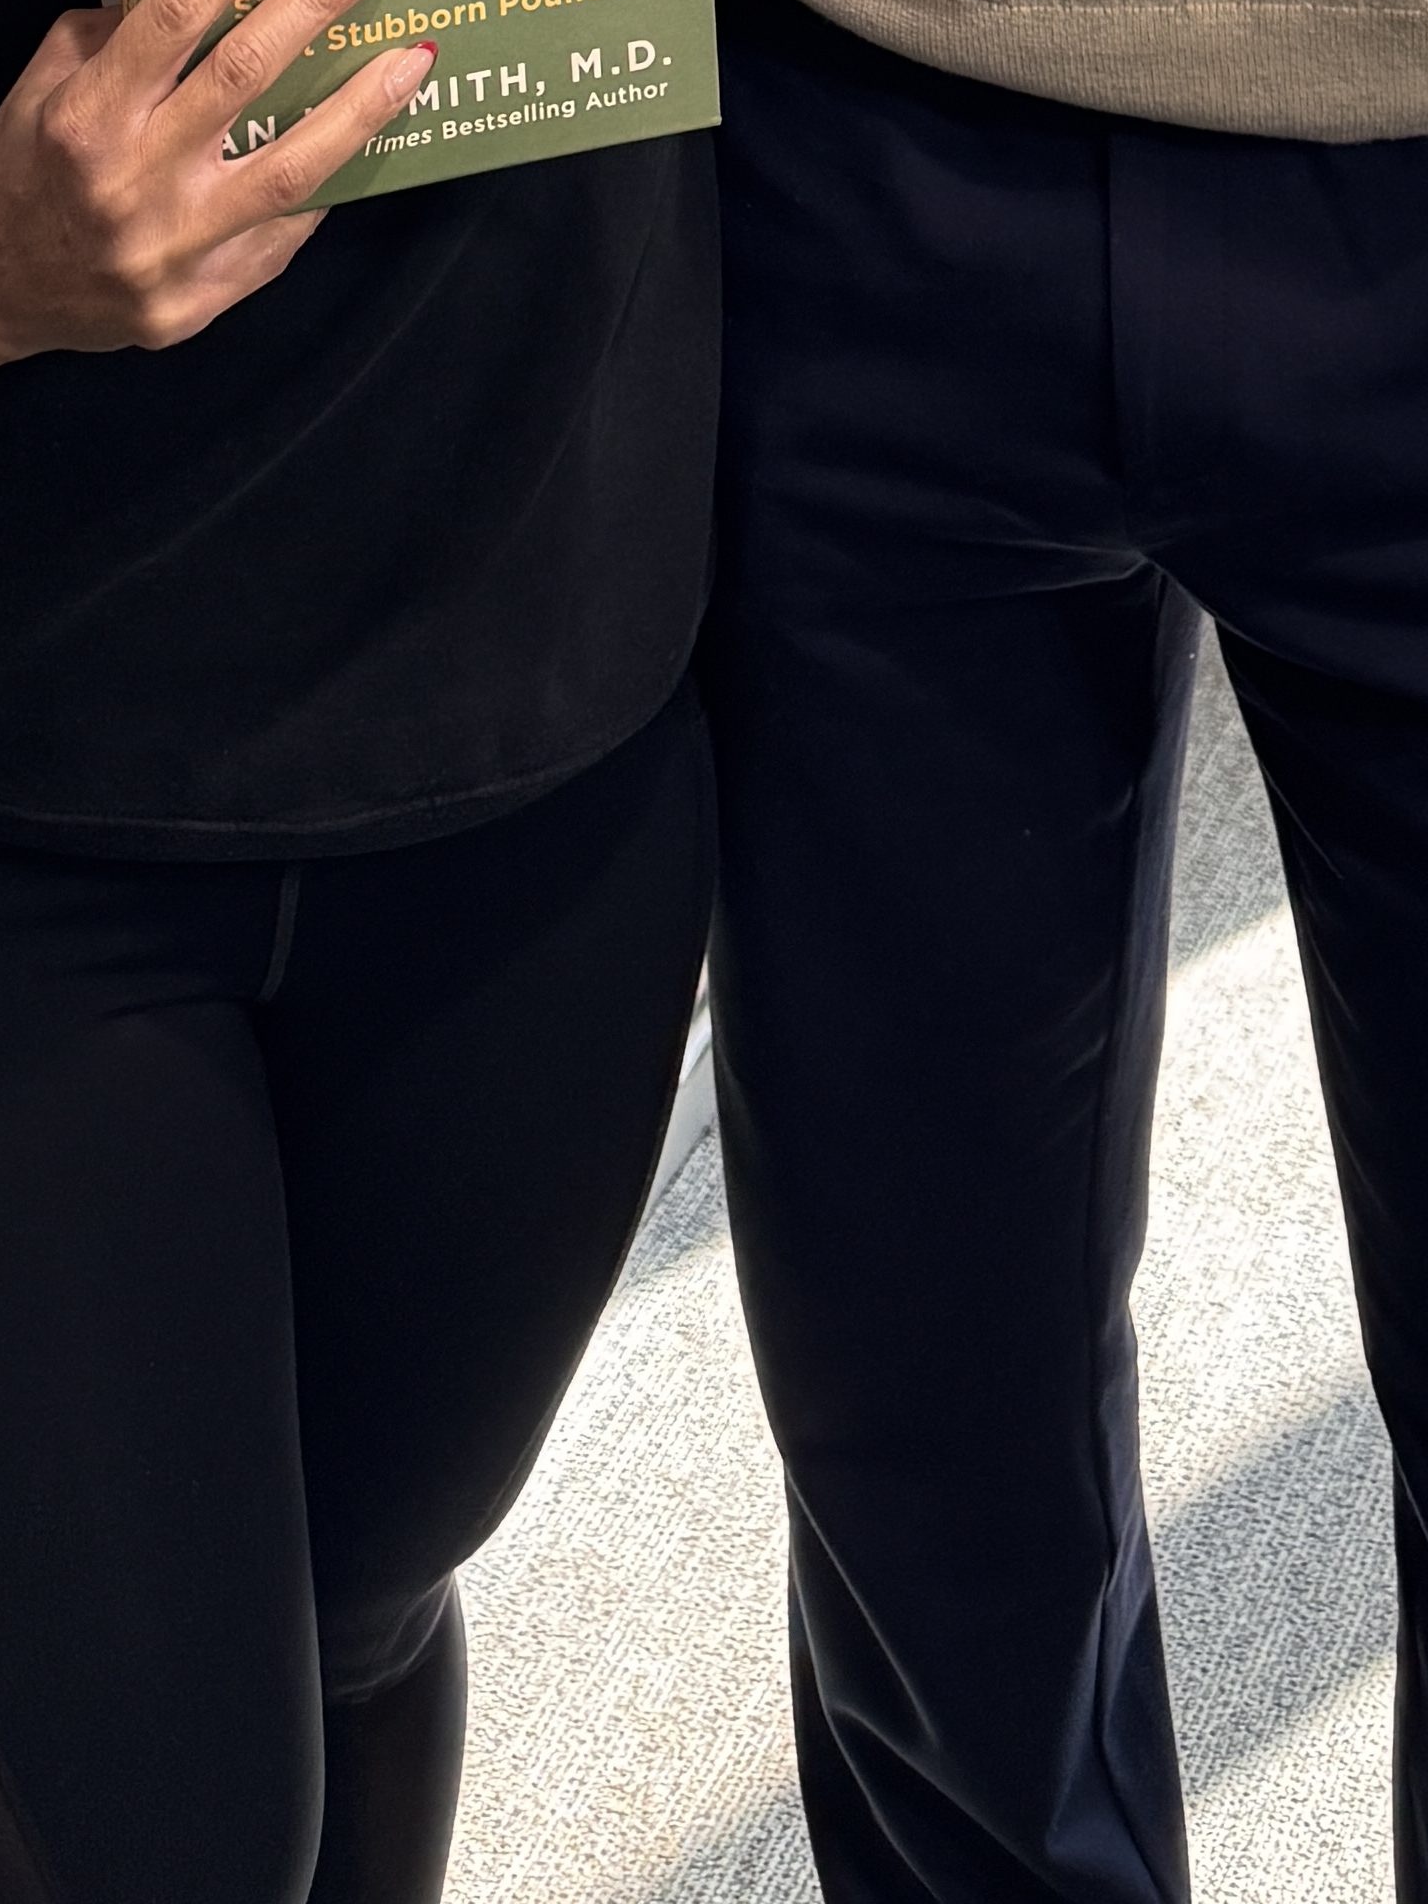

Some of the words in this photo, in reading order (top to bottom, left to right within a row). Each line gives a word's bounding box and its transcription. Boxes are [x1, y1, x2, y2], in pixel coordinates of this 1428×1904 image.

[571, 39, 674, 83] M.D.
[442, 99, 577, 142] Bestselling
[586, 79, 668, 111] Author
